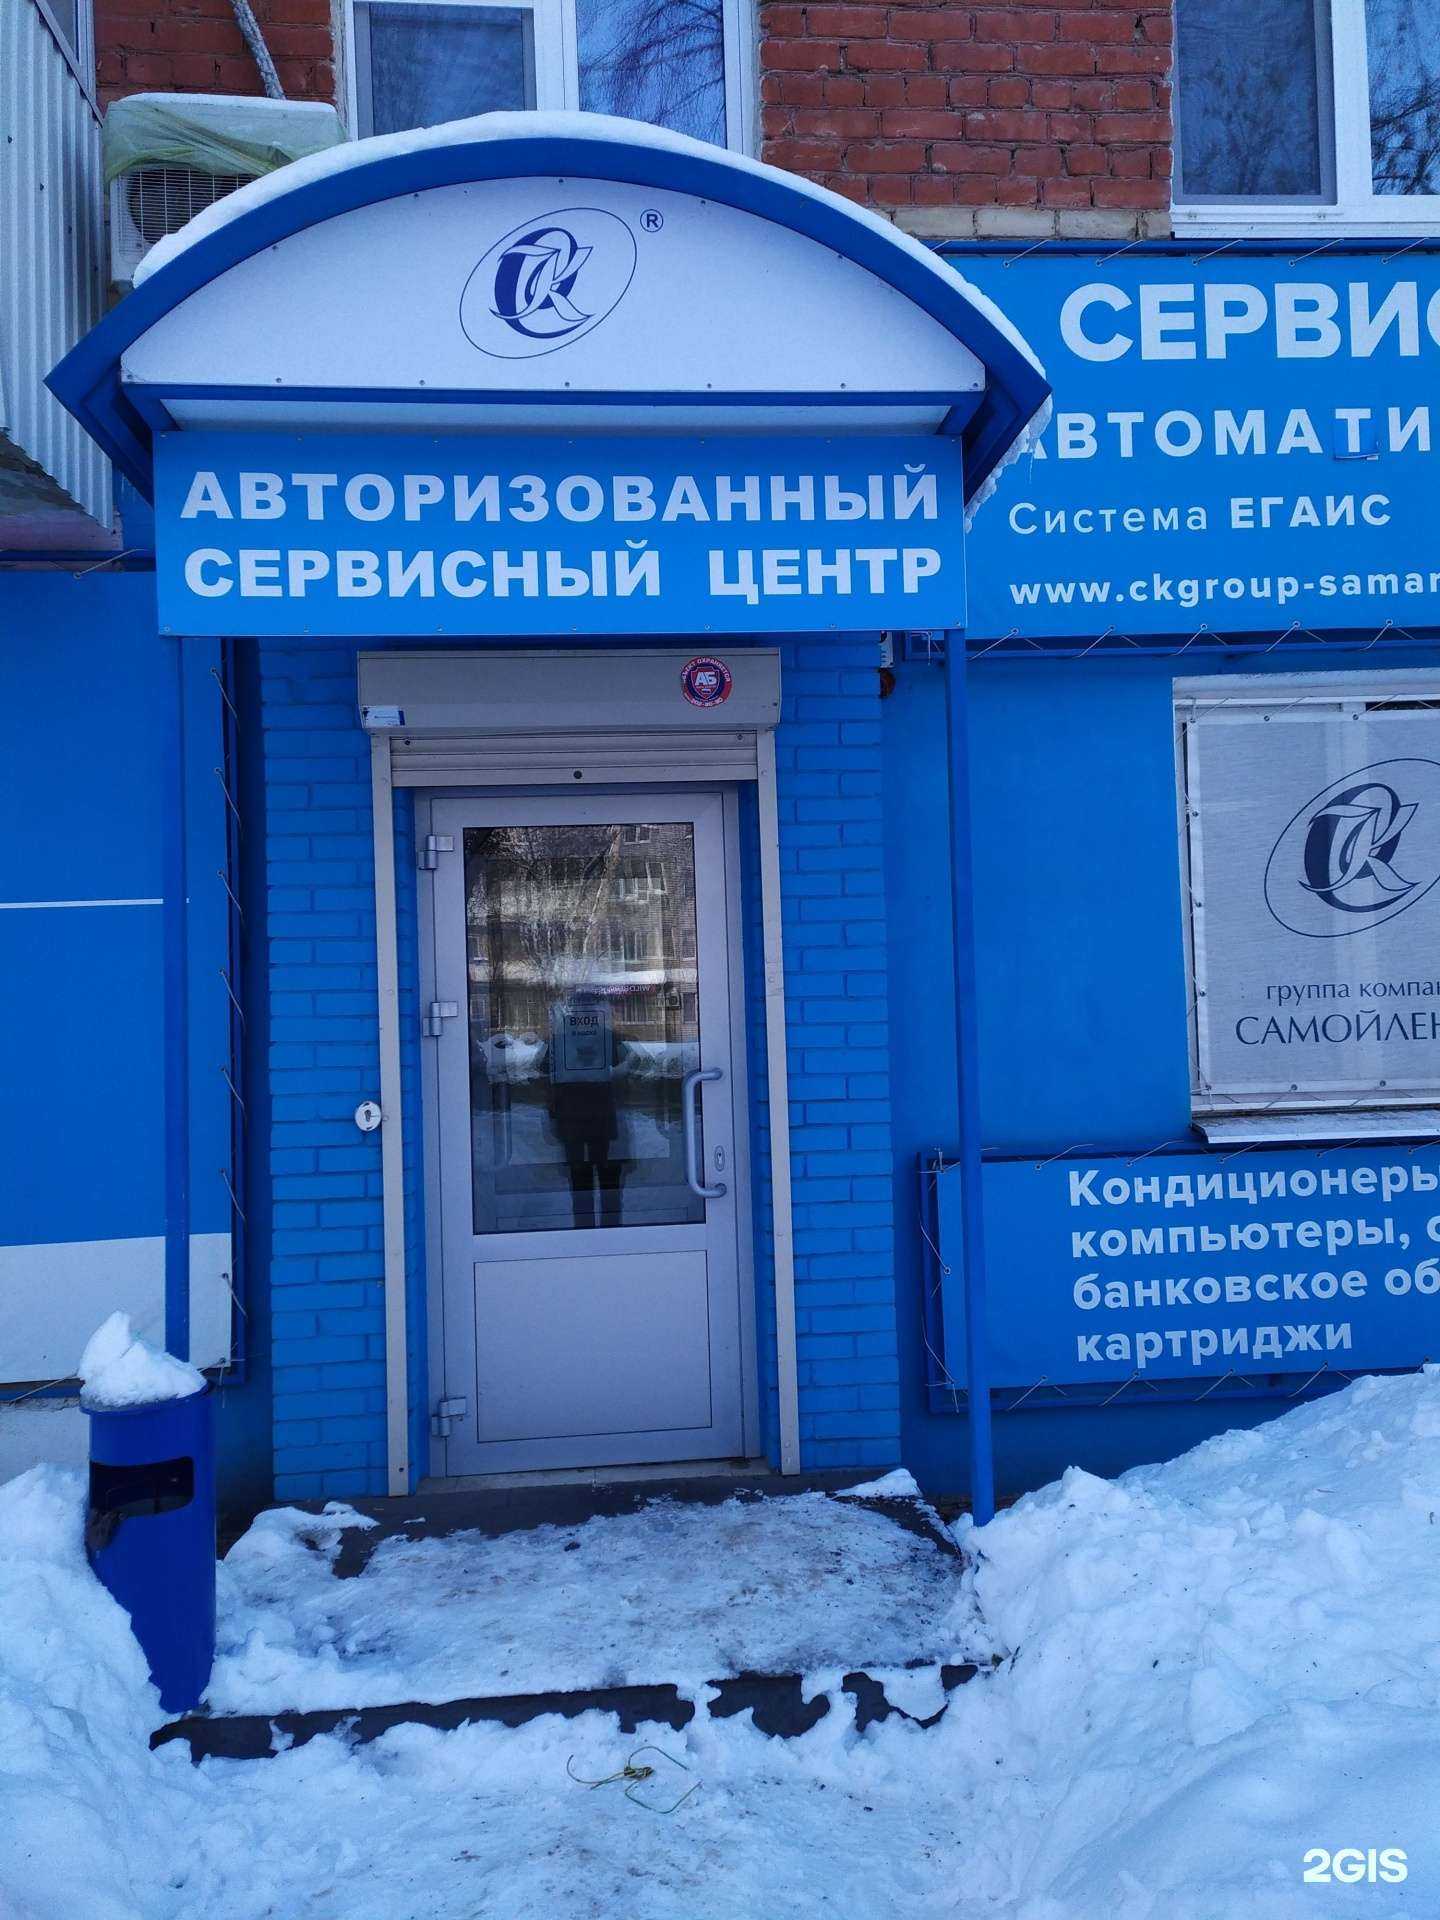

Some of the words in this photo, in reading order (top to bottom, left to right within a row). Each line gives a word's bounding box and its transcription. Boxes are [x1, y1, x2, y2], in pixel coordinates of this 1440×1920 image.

[1060, 281, 1440, 362] СЕРВИ
[1030, 406, 1431, 460] ВТОМАТИ
[180, 463, 938, 522] АВТОРИЗОВАННЫЙ
[1009, 502, 1207, 535] Система
[1230, 494, 1391, 529] ЕГАИС
[184, 539, 660, 598] СЕРВИСНЫЙ
[708, 548, 941, 605] ЦЕНТР
[1009, 572, 1440, 608] www.ckgroup-samar
[1266, 983, 1351, 1007] группа
[1359, 981, 1440, 998] компа
[569, 1016, 600, 1028] ВХОД
[1071, 1218, 1411, 1256] компьютеры,
[1073, 1270, 1368, 1310] банковское
[1384, 1258, 1440, 1296] об
[1077, 1322, 1352, 1369] картриджи
